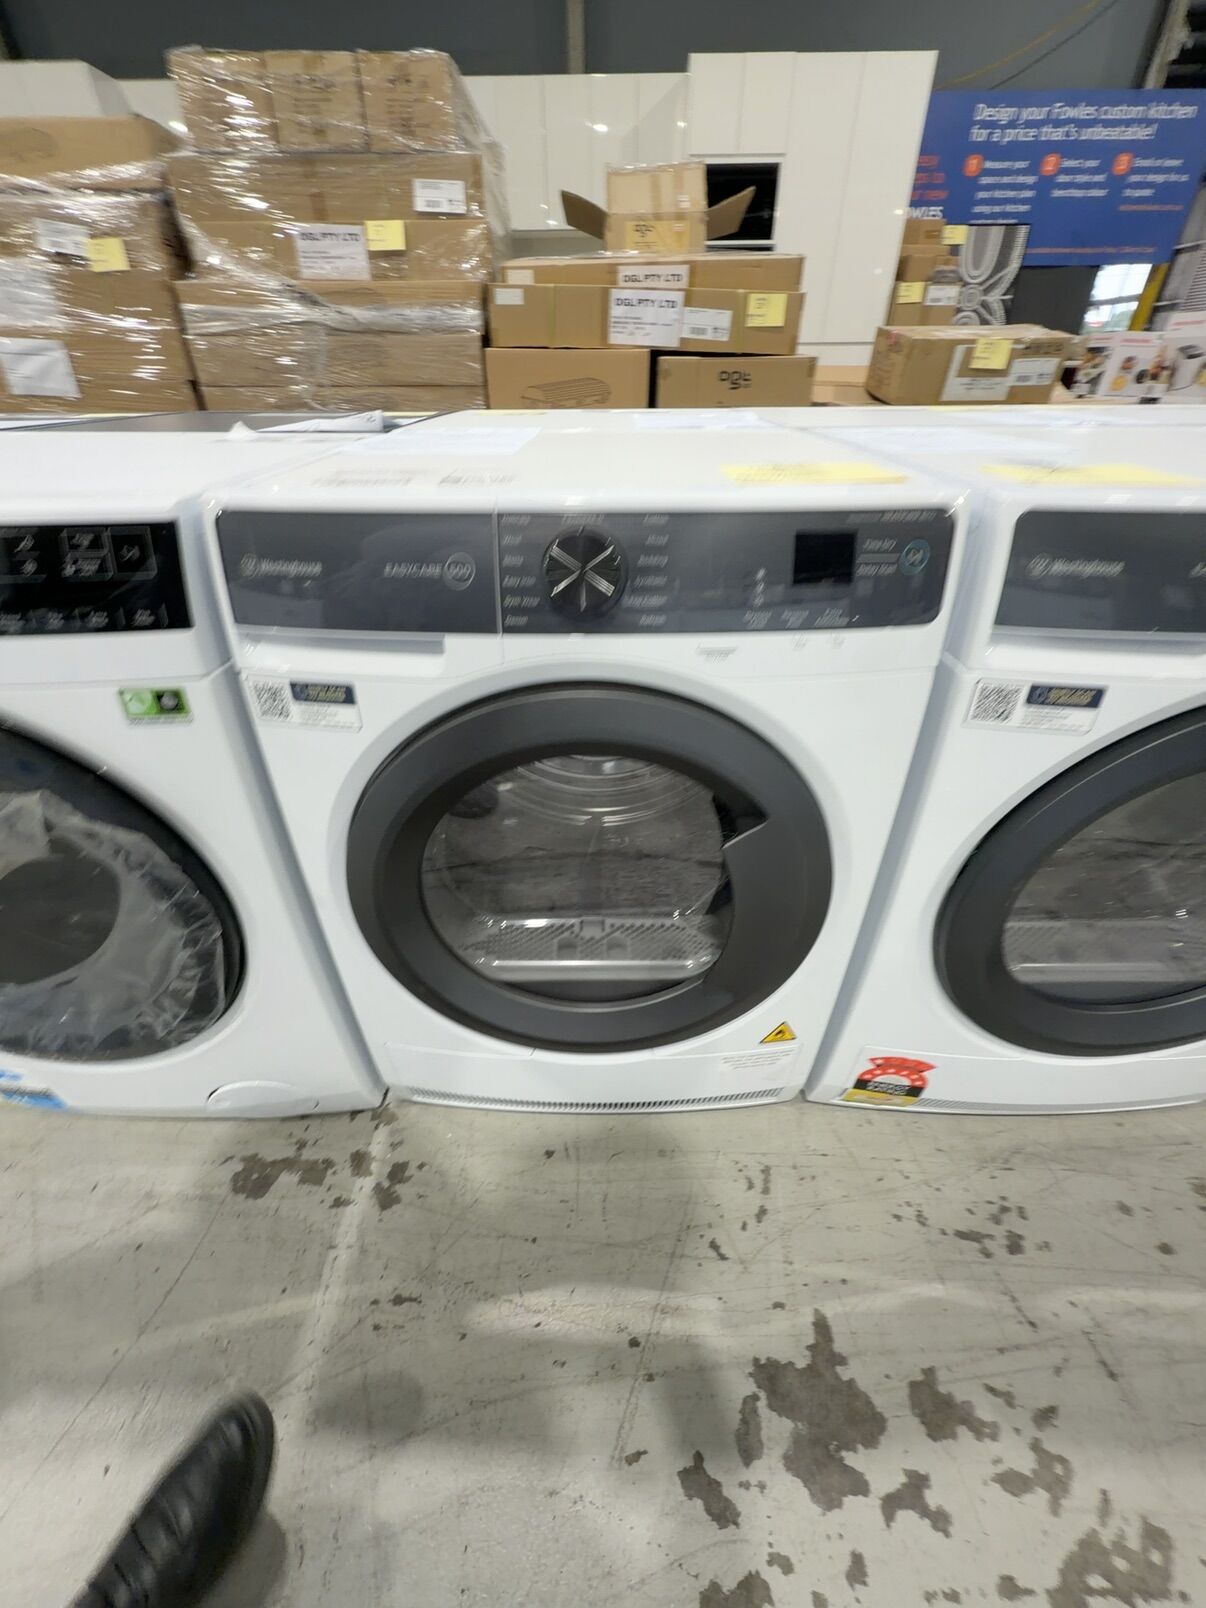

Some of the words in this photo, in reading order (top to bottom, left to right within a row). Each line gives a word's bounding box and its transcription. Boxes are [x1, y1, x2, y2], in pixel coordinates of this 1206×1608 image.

[973, 103, 1017, 124] Design
[1017, 106, 1050, 123] your
[1097, 105, 1146, 119] custom
[1147, 102, 1198, 119] kitchen
[970, 124, 991, 141] for
[991, 128, 1001, 141] a
[1001, 125, 1037, 144] price
[1038, 124, 1077, 140] that's
